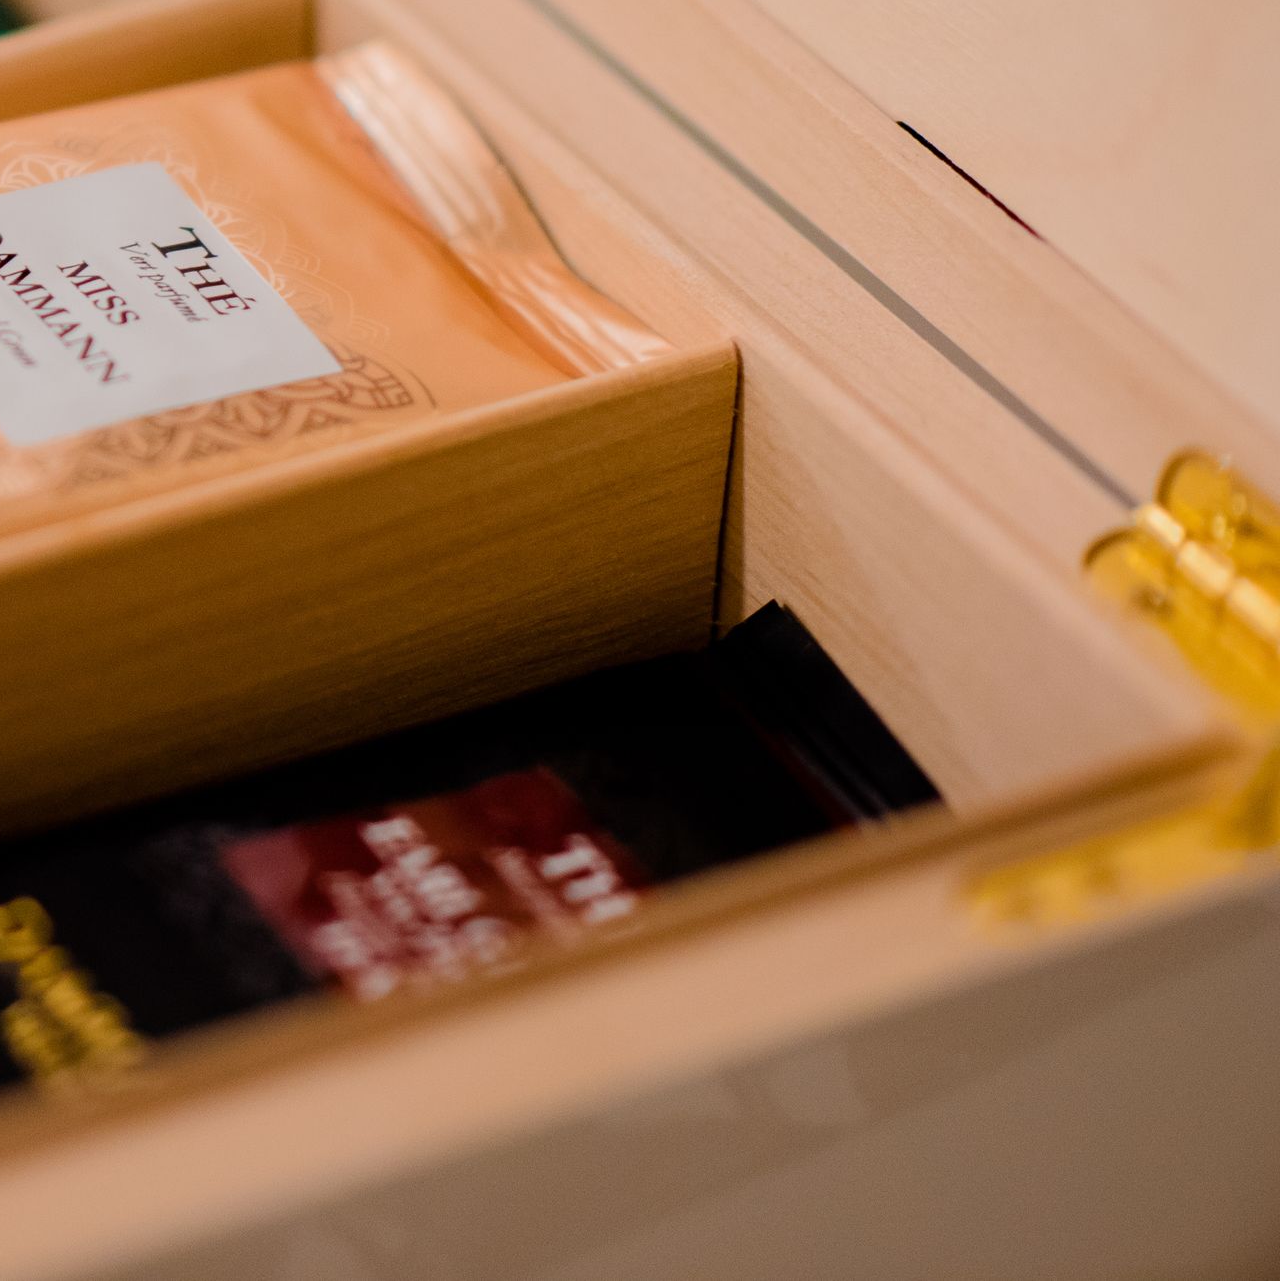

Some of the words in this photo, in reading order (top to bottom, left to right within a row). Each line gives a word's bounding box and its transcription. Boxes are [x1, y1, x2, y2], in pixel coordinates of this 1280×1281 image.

[119, 242, 158, 270] Vert
[151, 225, 257, 316] THÉ
[57, 259, 141, 326] MISS
